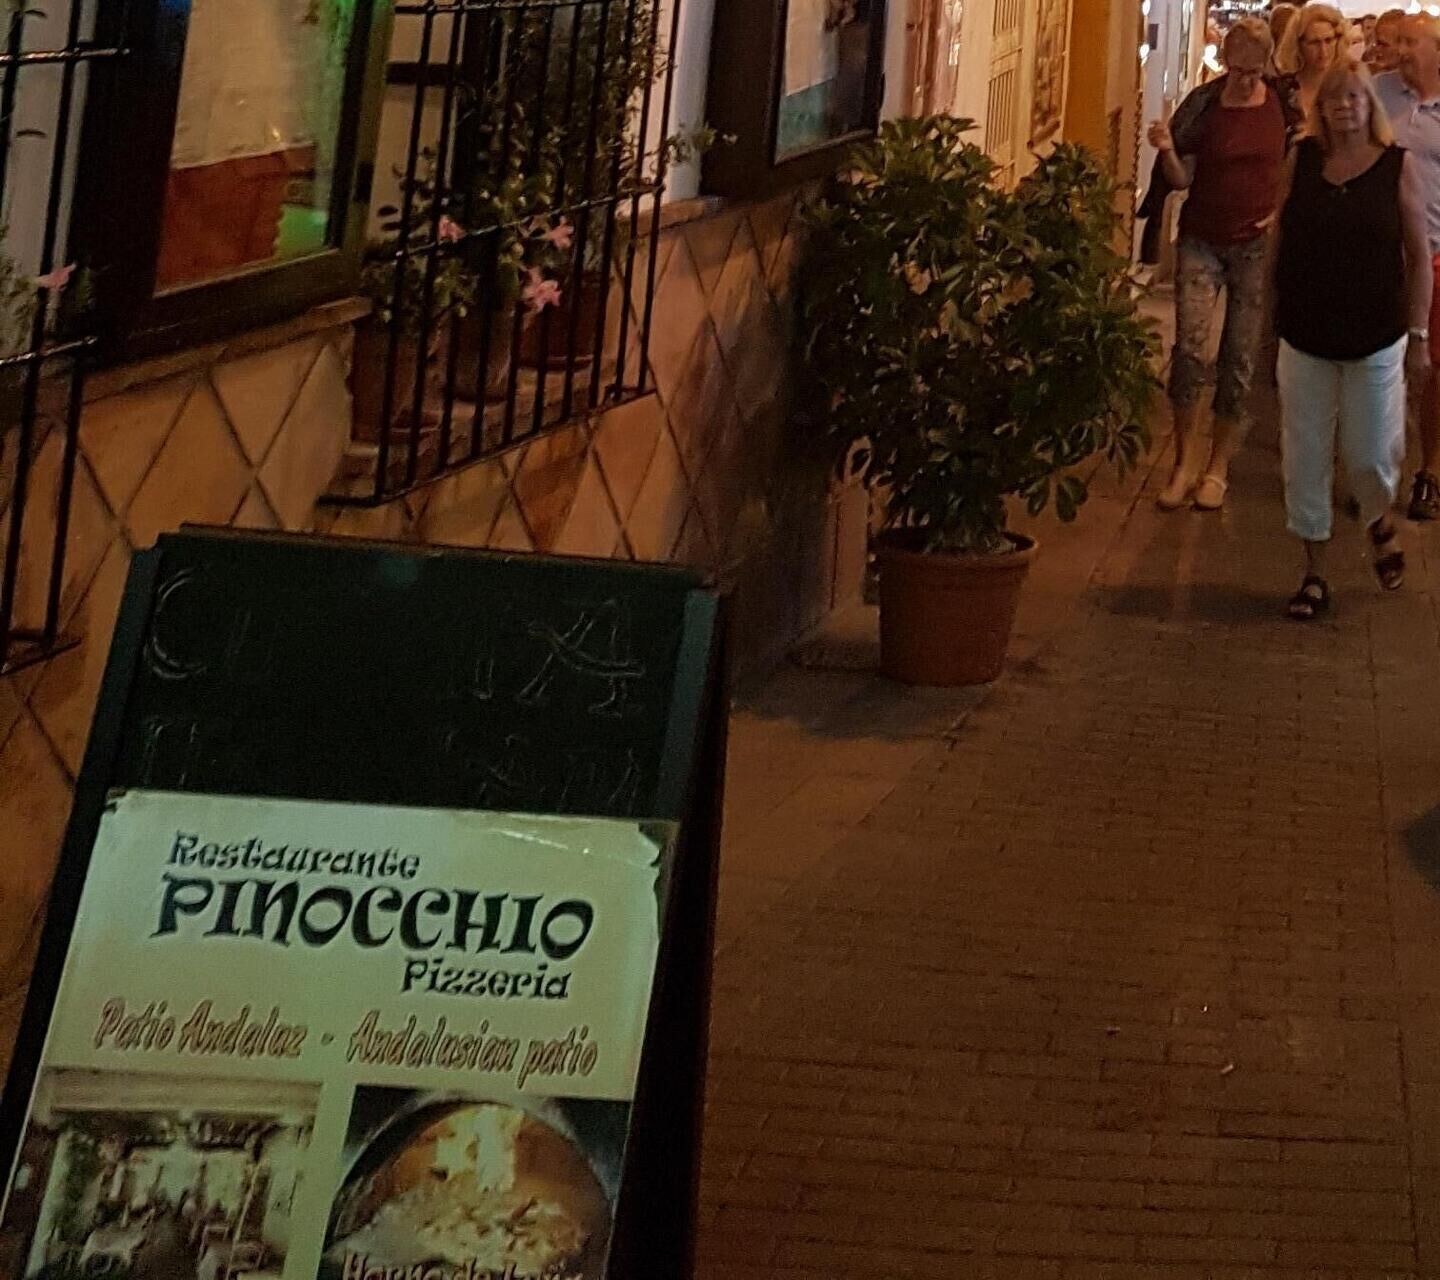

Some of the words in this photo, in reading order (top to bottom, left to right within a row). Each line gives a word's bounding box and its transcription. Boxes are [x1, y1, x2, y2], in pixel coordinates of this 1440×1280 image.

[167, 829, 421, 880] Restaurante
[149, 872, 595, 961] PINOCCHIO
[401, 957, 573, 1000] Pizzeria
[94, 997, 174, 1052] Patio
[178, 998, 308, 1059] Andaluz
[346, 1009, 515, 1074] Andalusian
[515, 1024, 599, 1090] patio
